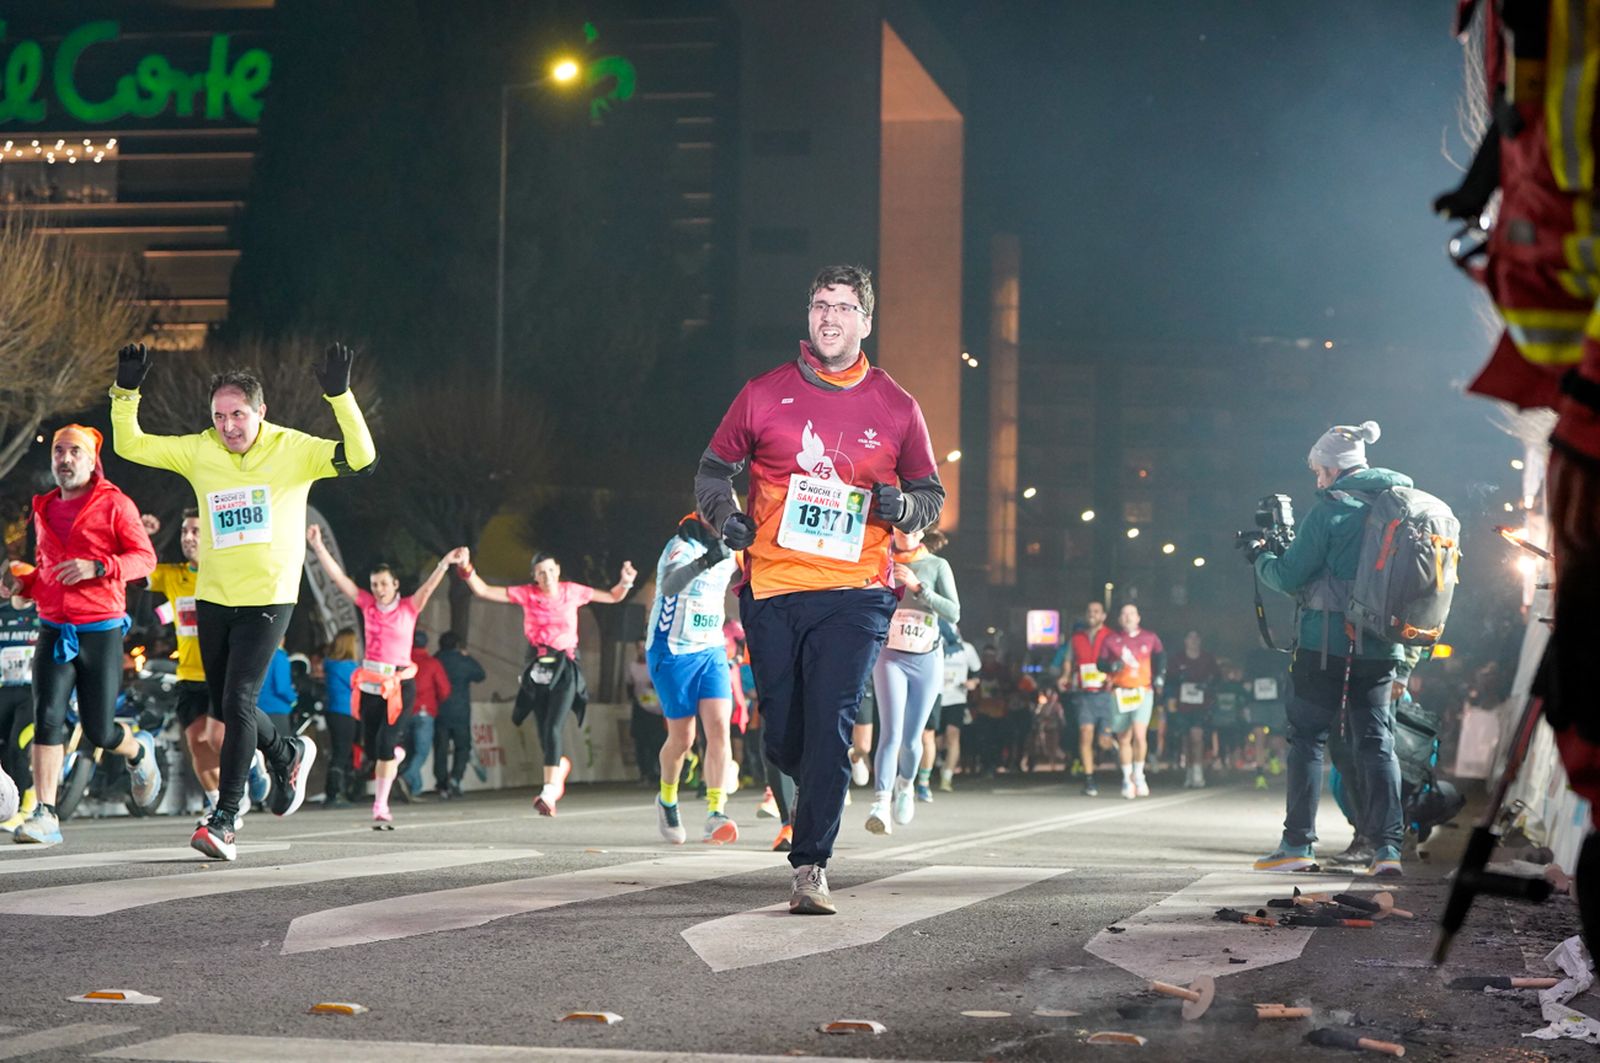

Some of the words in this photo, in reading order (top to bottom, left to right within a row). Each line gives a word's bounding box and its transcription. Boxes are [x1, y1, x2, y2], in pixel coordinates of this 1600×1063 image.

[54, 19, 272, 123] Corte
[812, 462, 832, 480] 43
[797, 493, 814, 503] SAN
[808, 486, 831, 497] NOCHE
[218, 506, 264, 529] 13198
[799, 504, 854, 534] 13170
[693, 613, 720, 627] 9562
